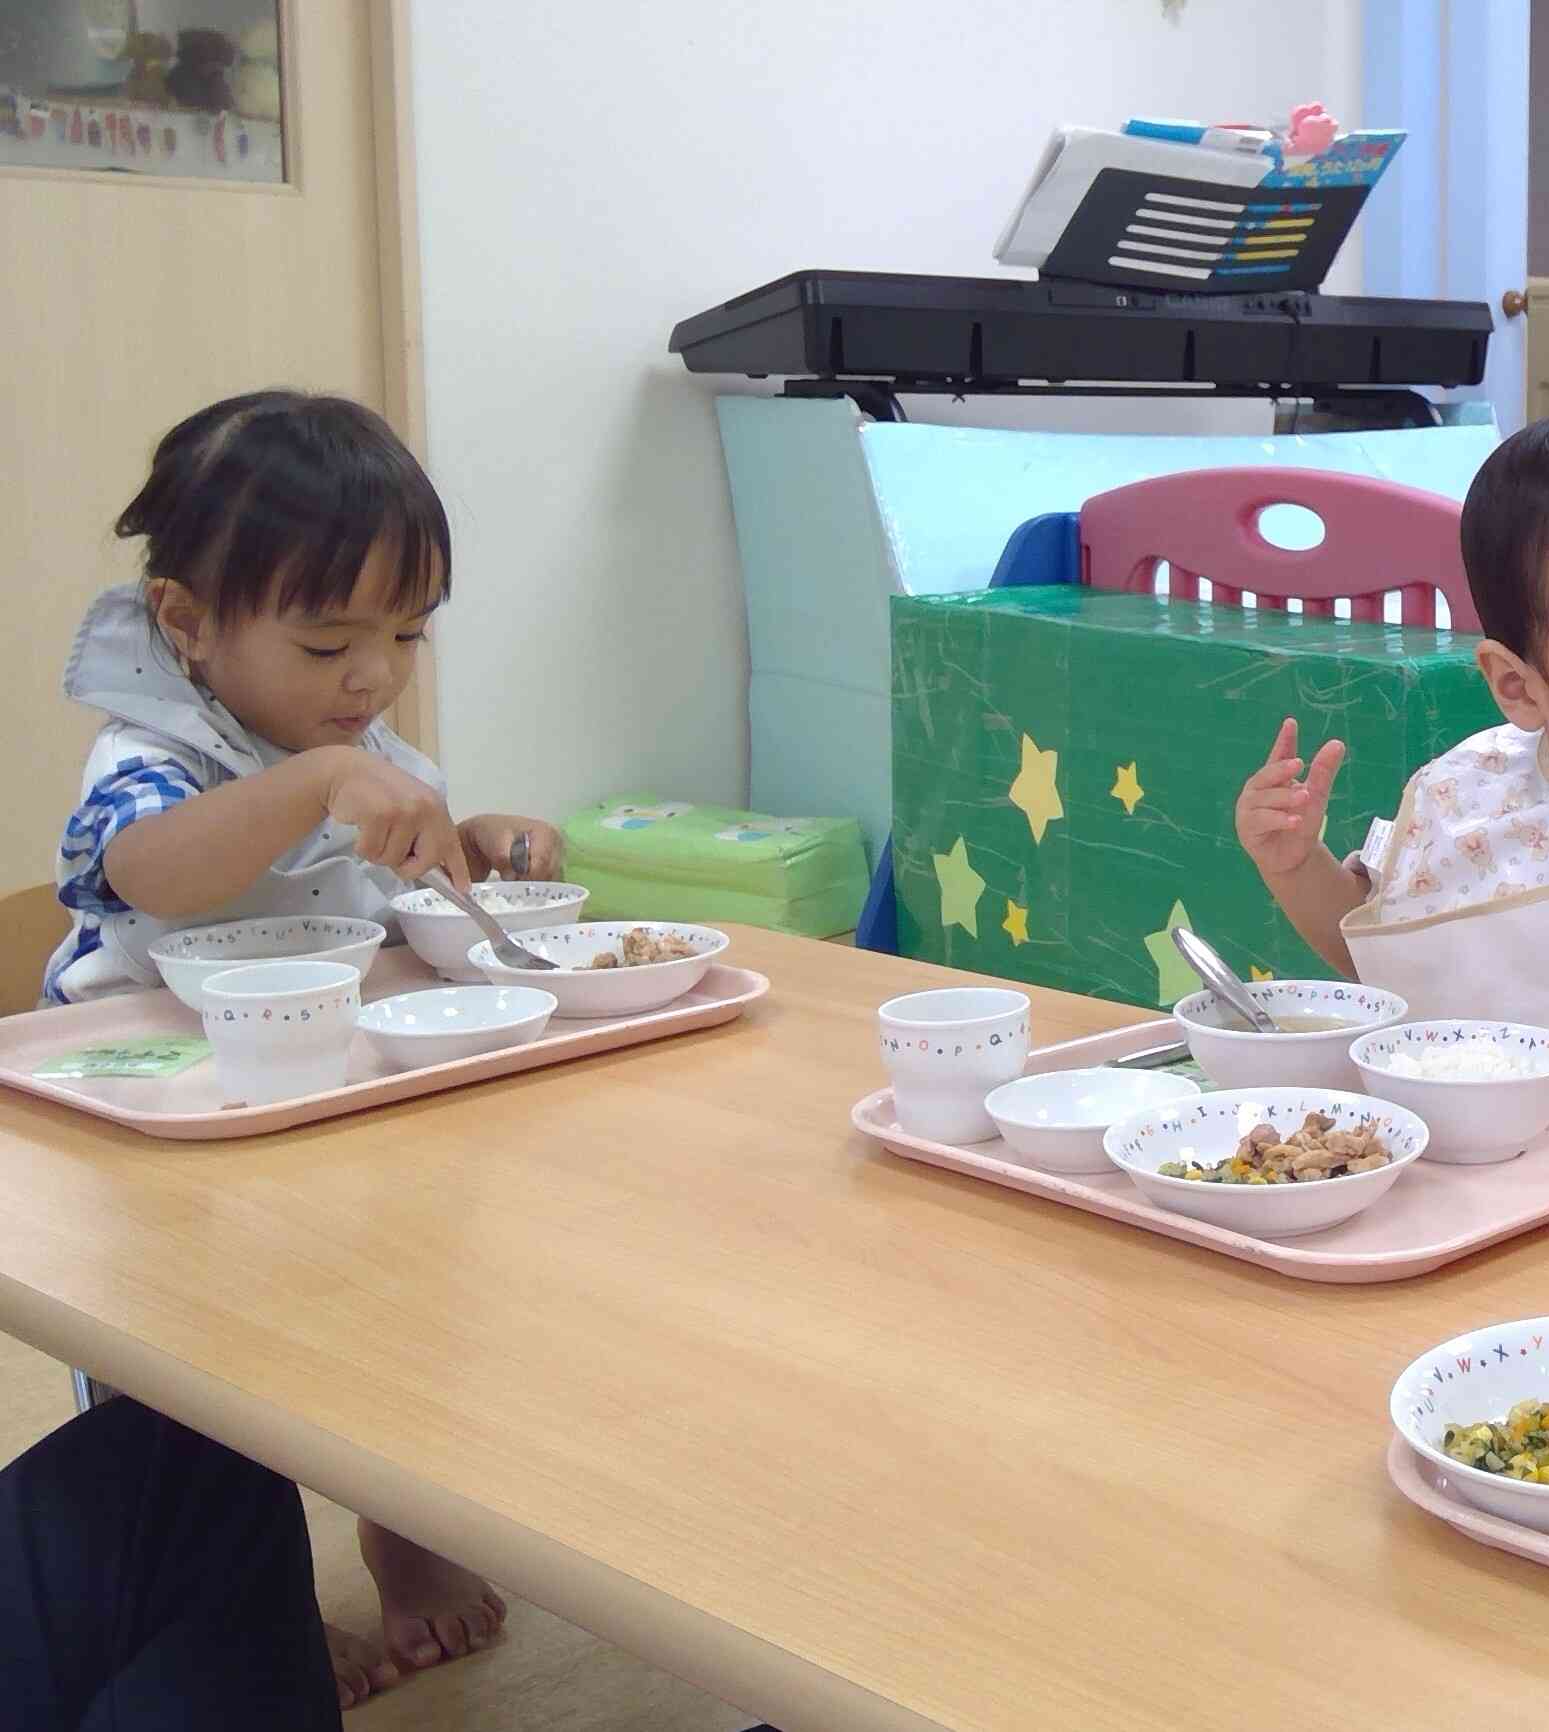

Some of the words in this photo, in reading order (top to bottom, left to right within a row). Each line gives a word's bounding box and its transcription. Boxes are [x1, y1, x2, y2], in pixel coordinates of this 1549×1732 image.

[1334, 989, 1346, 1001] Q
[224, 1009, 236, 1021] Q
[301, 1009, 311, 1021] S
[989, 1033, 1003, 1046] Q
[1424, 1030, 1439, 1042] W
[1453, 1028, 1465, 1041] X
[1456, 1357, 1472, 1375] W
[1492, 1343, 1510, 1363] X
[1532, 1335, 1543, 1350] Y
